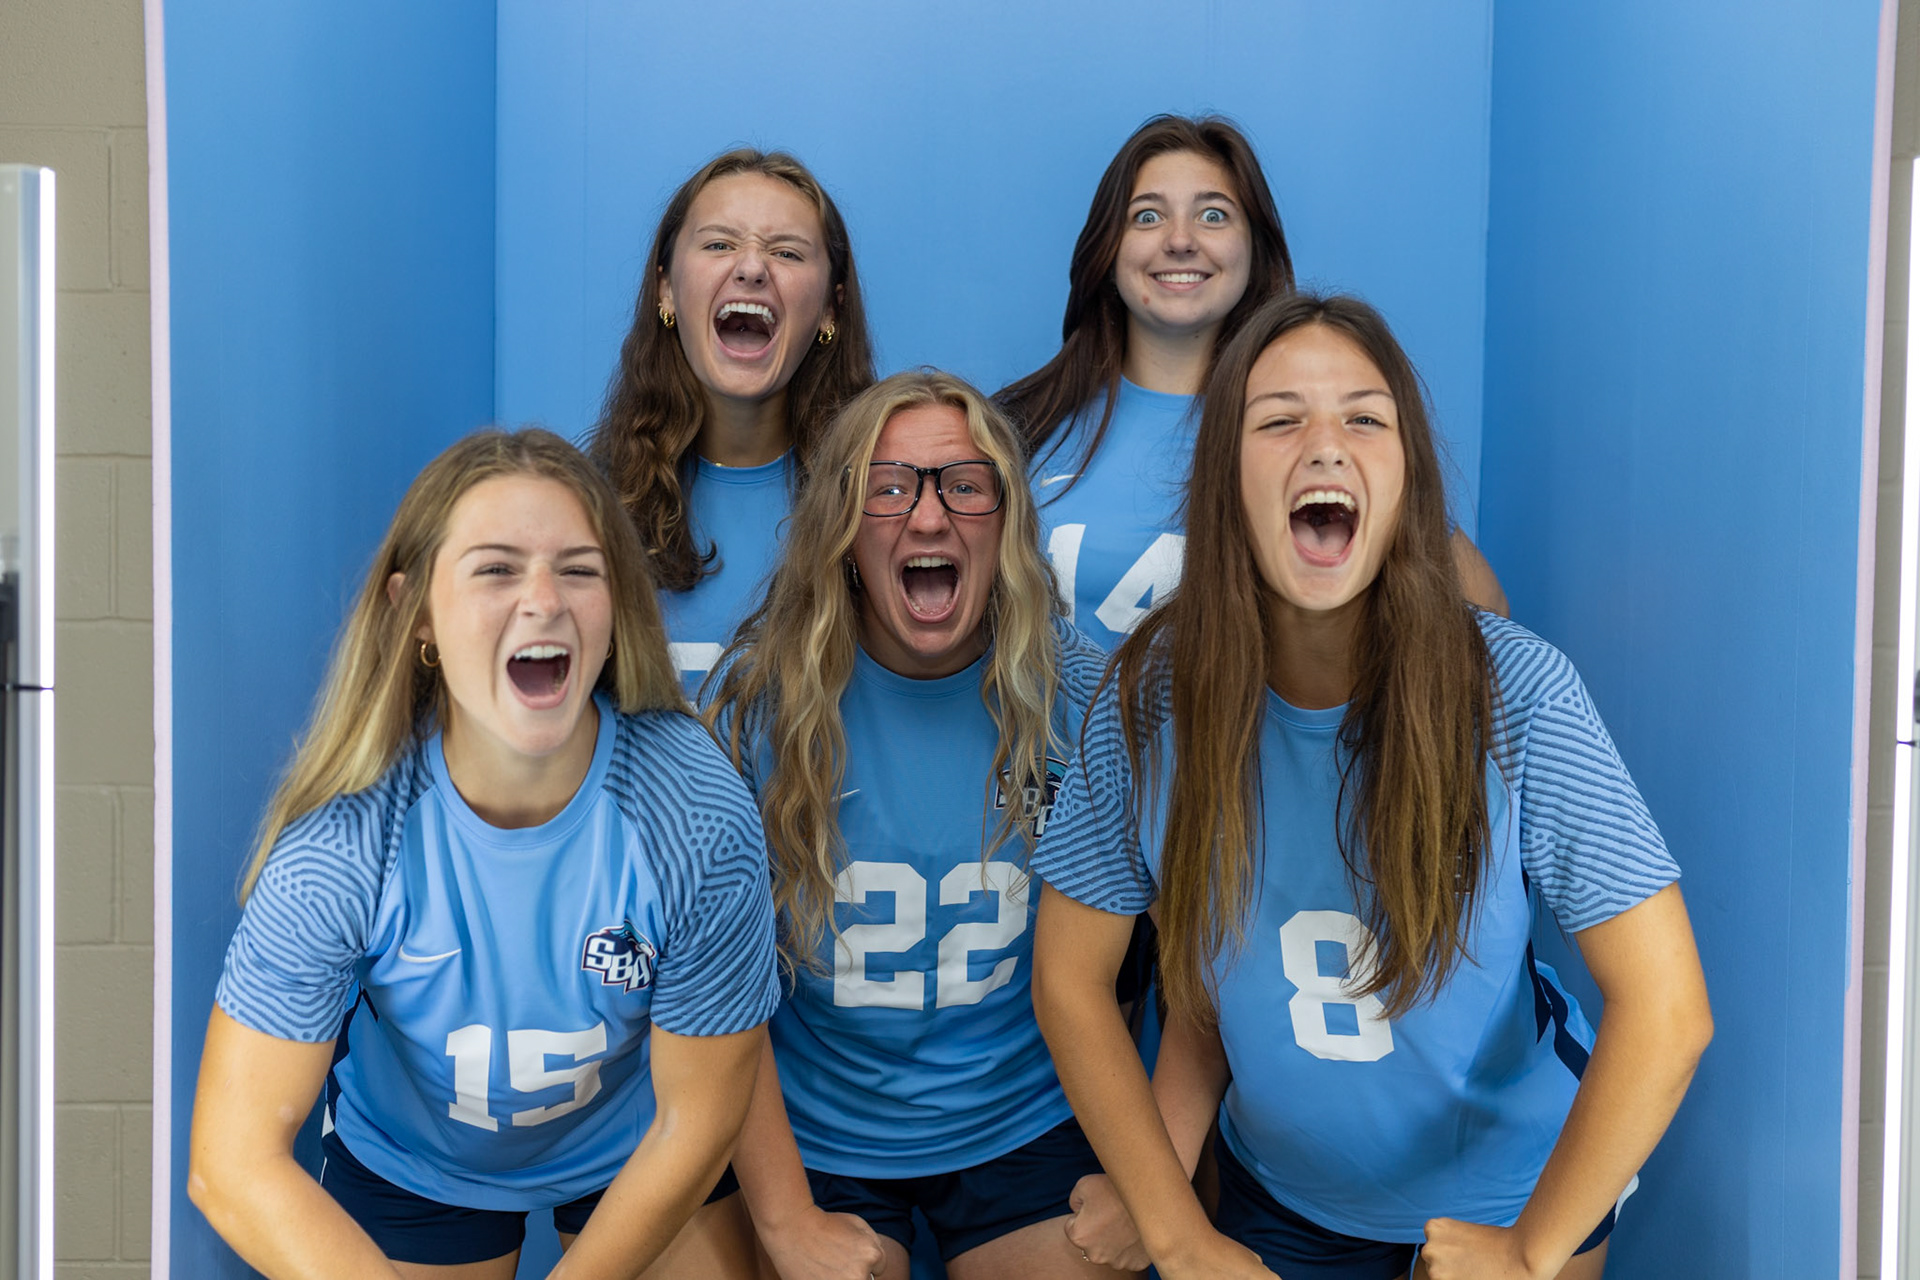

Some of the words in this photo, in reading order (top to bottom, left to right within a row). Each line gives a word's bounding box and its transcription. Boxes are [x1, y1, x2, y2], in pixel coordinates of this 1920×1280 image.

[1047, 522, 1187, 635] 14
[586, 937, 651, 989] SBA
[833, 860, 1030, 1011] 22
[1279, 910, 1395, 1062] 8
[445, 1020, 608, 1132] 15
